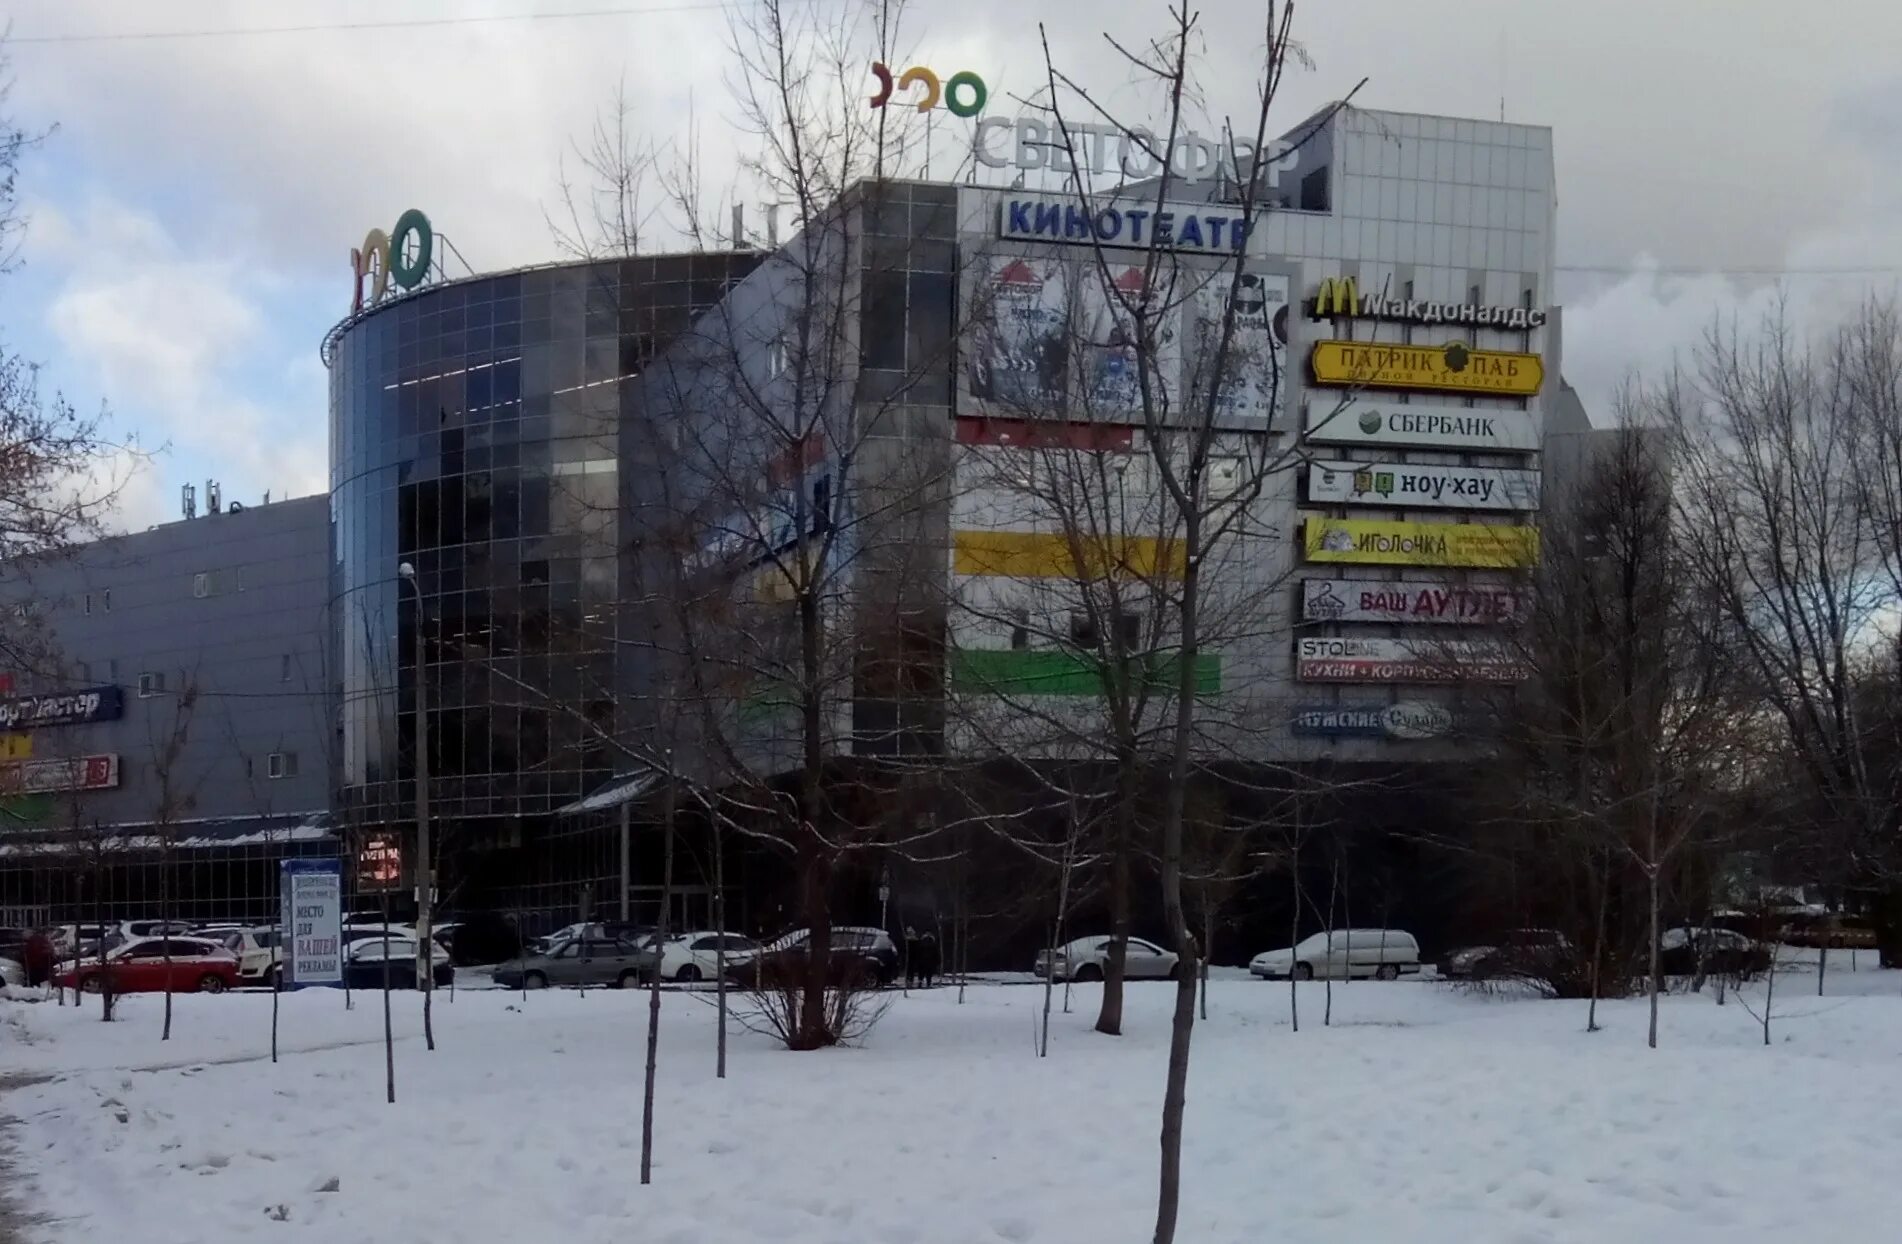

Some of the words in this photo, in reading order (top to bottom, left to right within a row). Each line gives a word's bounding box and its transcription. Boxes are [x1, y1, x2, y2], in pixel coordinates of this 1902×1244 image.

[974, 116, 1300, 188] СВЕТОФОР
[1009, 200, 1247, 250] КИНОТЕАТР
[1363, 293, 1545, 328] Макдоналдс
[1340, 347, 1434, 372] ПАТРИК
[1473, 356, 1520, 377] ПАБ
[1388, 412, 1496, 437] СБЕРБАНК
[1358, 533, 1447, 555] ИГОЛОЧКА
[1359, 591, 1408, 614] ВАШ
[295, 905, 324, 919] МЕСТО
